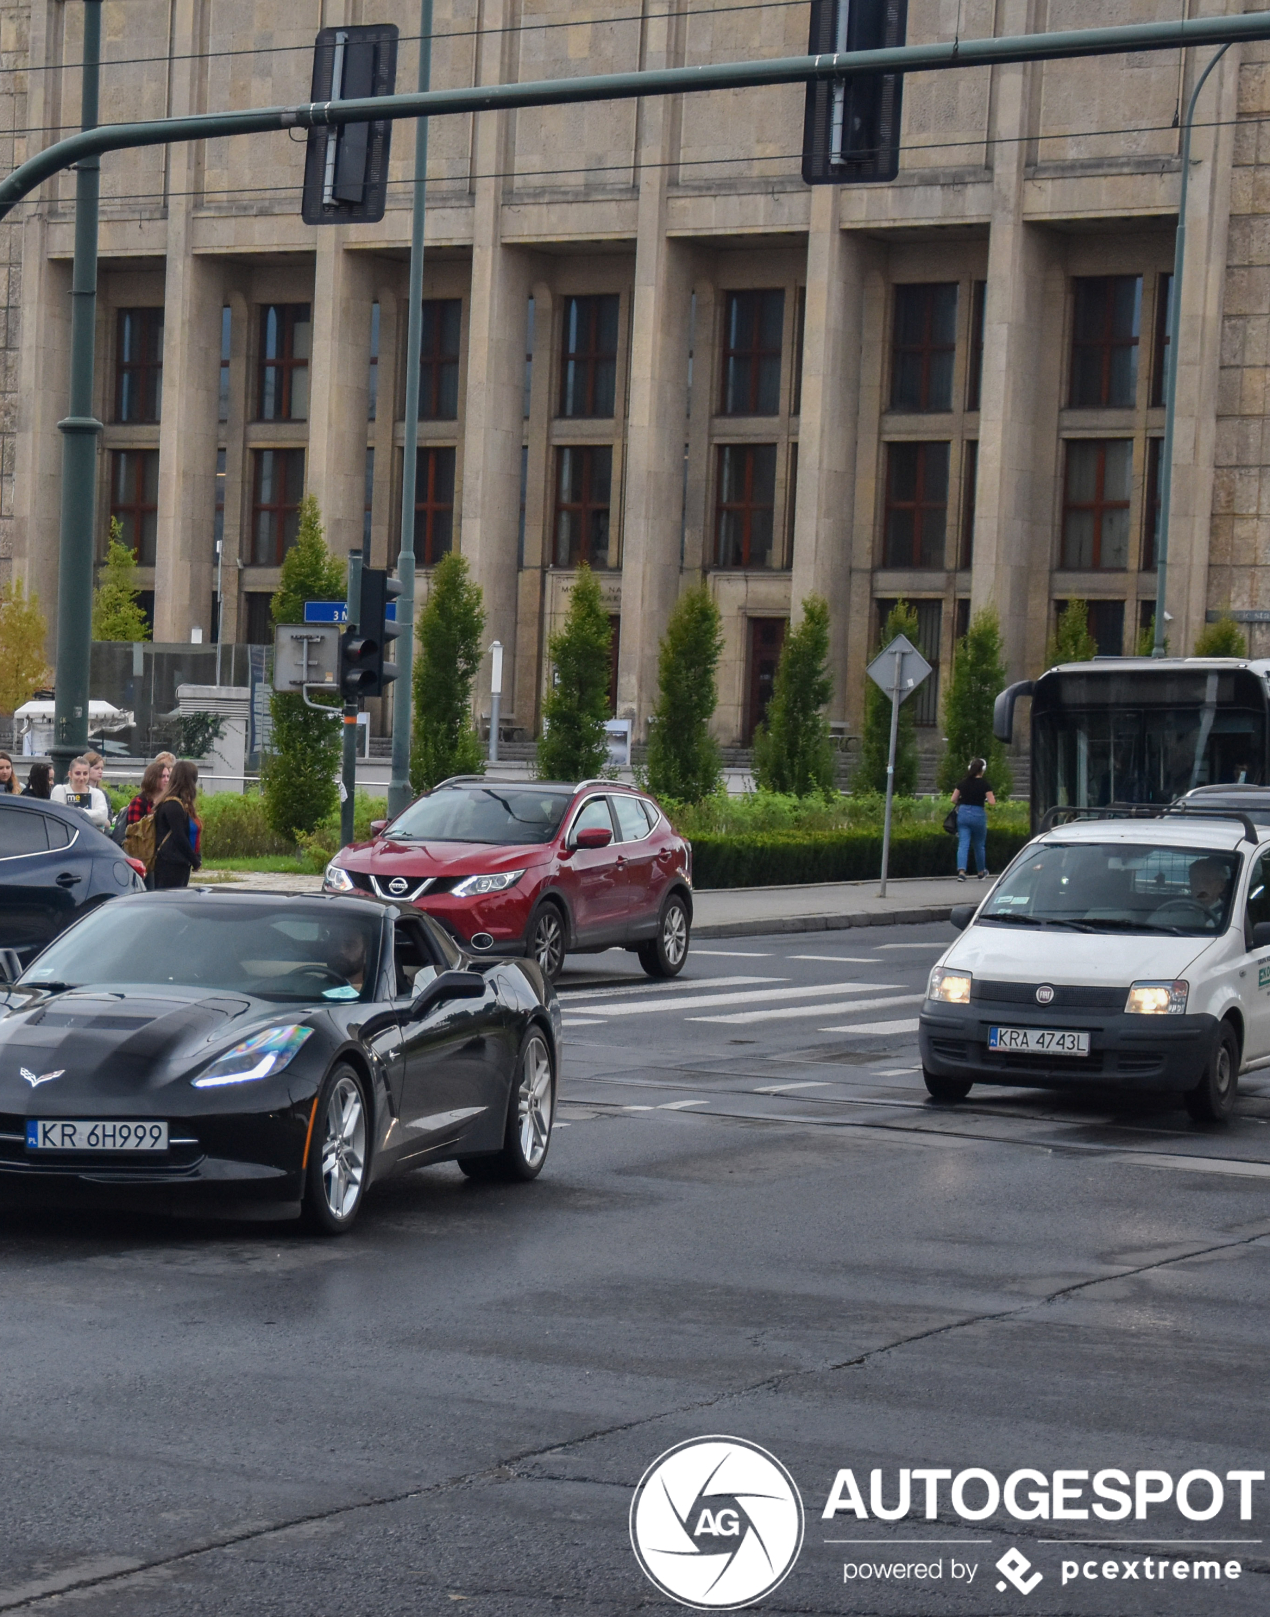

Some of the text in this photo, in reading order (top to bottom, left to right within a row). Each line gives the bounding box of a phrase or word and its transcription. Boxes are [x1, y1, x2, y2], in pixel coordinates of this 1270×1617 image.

[333, 610, 339, 621] 3
[998, 1030, 1029, 1048] KRA
[1036, 1033, 1086, 1051] 4743L
[42, 1123, 77, 1147] KR
[87, 1124, 162, 1148] 6H999
